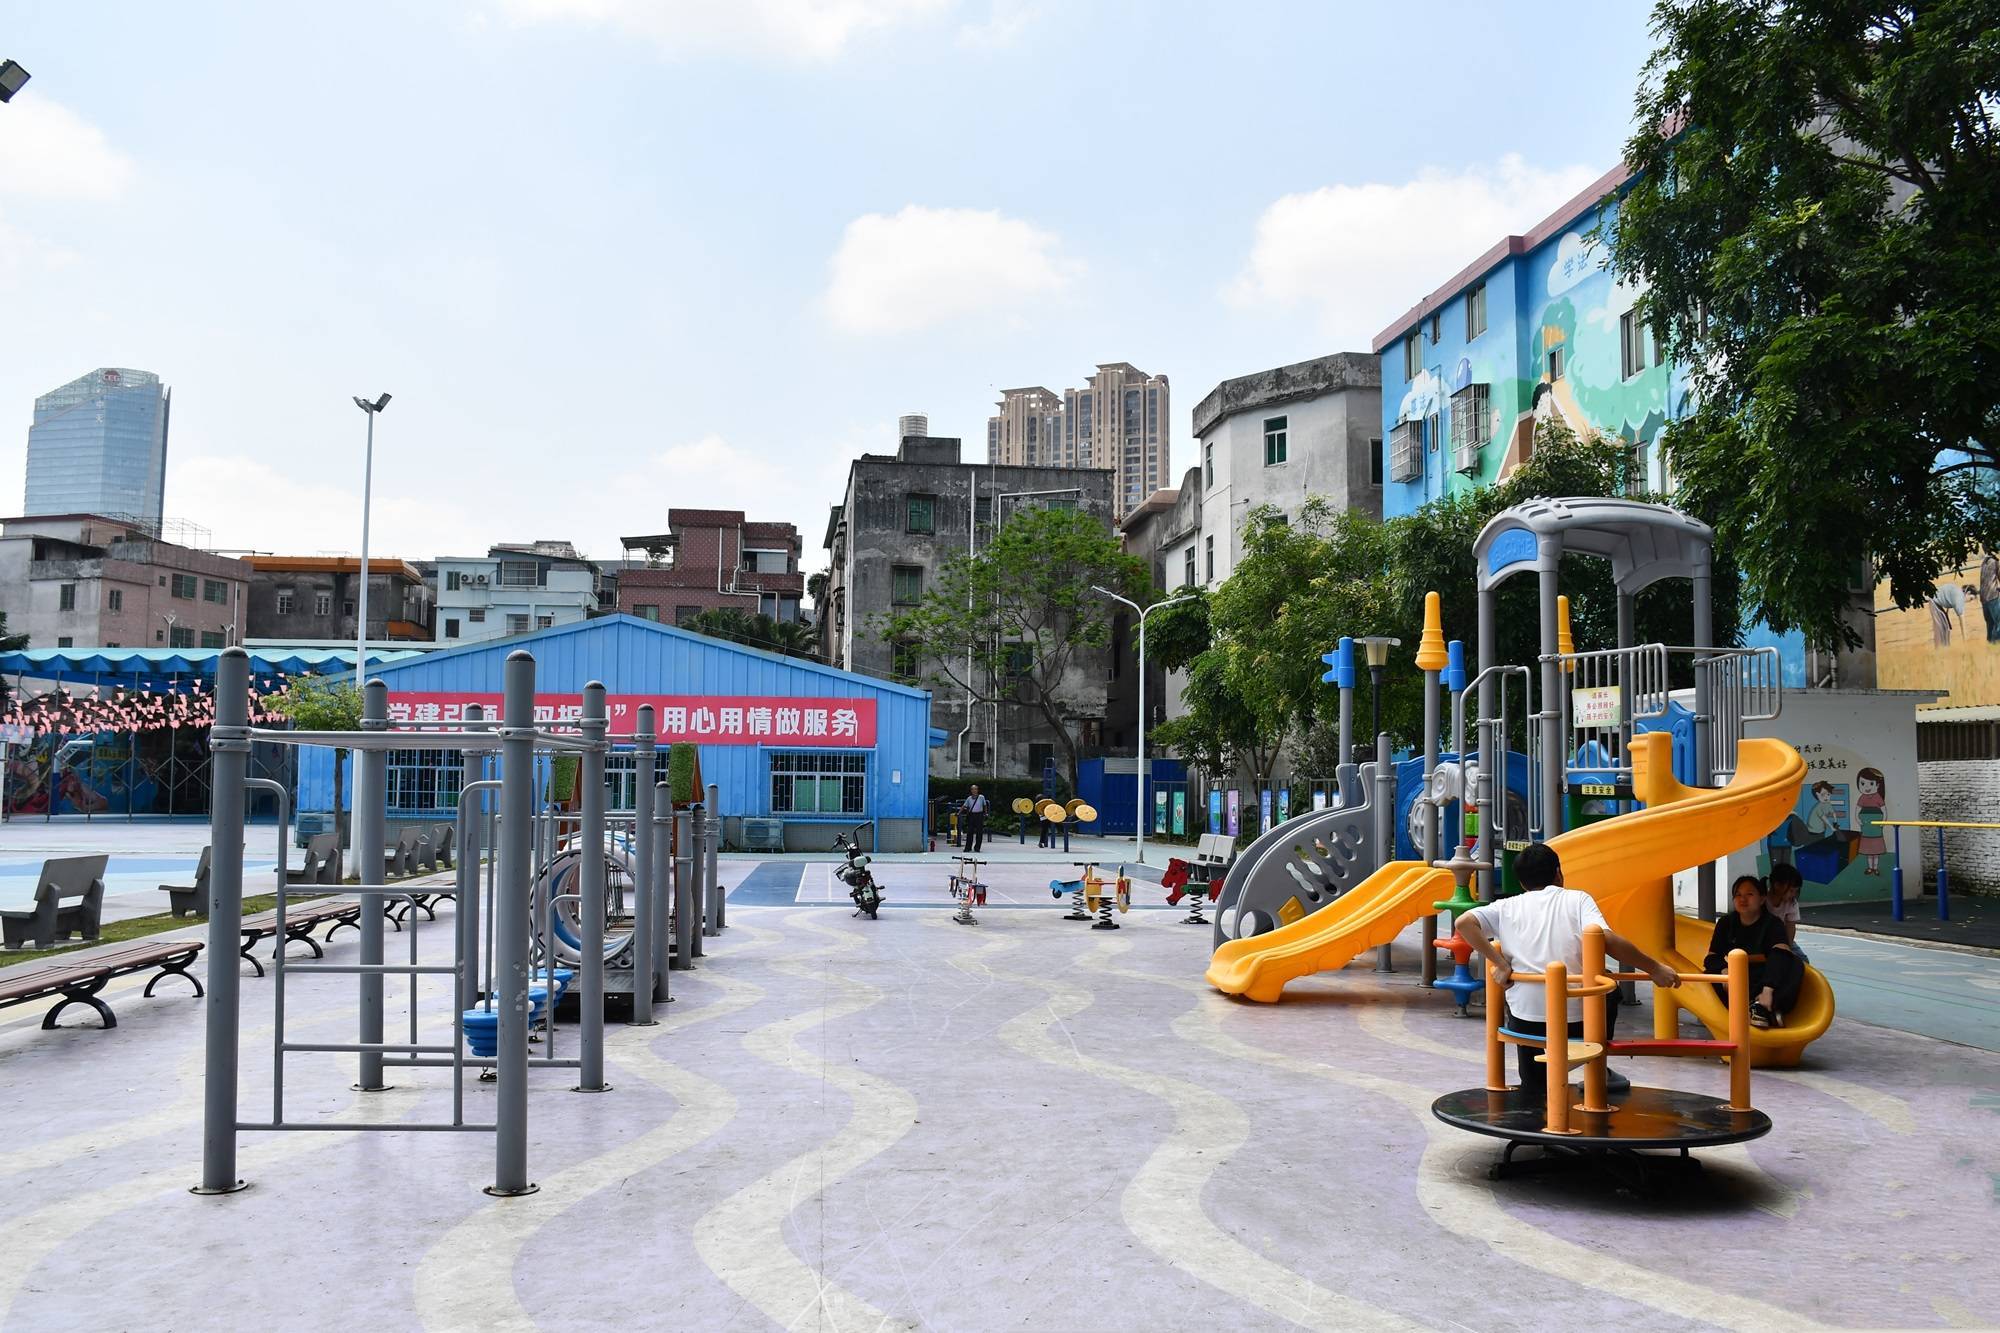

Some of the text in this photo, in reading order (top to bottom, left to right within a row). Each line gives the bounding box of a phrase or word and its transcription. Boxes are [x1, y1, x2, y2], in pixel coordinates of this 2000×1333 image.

[662, 706, 858, 737] 用心用情做服务
[1584, 785, 1612, 795] 注意安全
